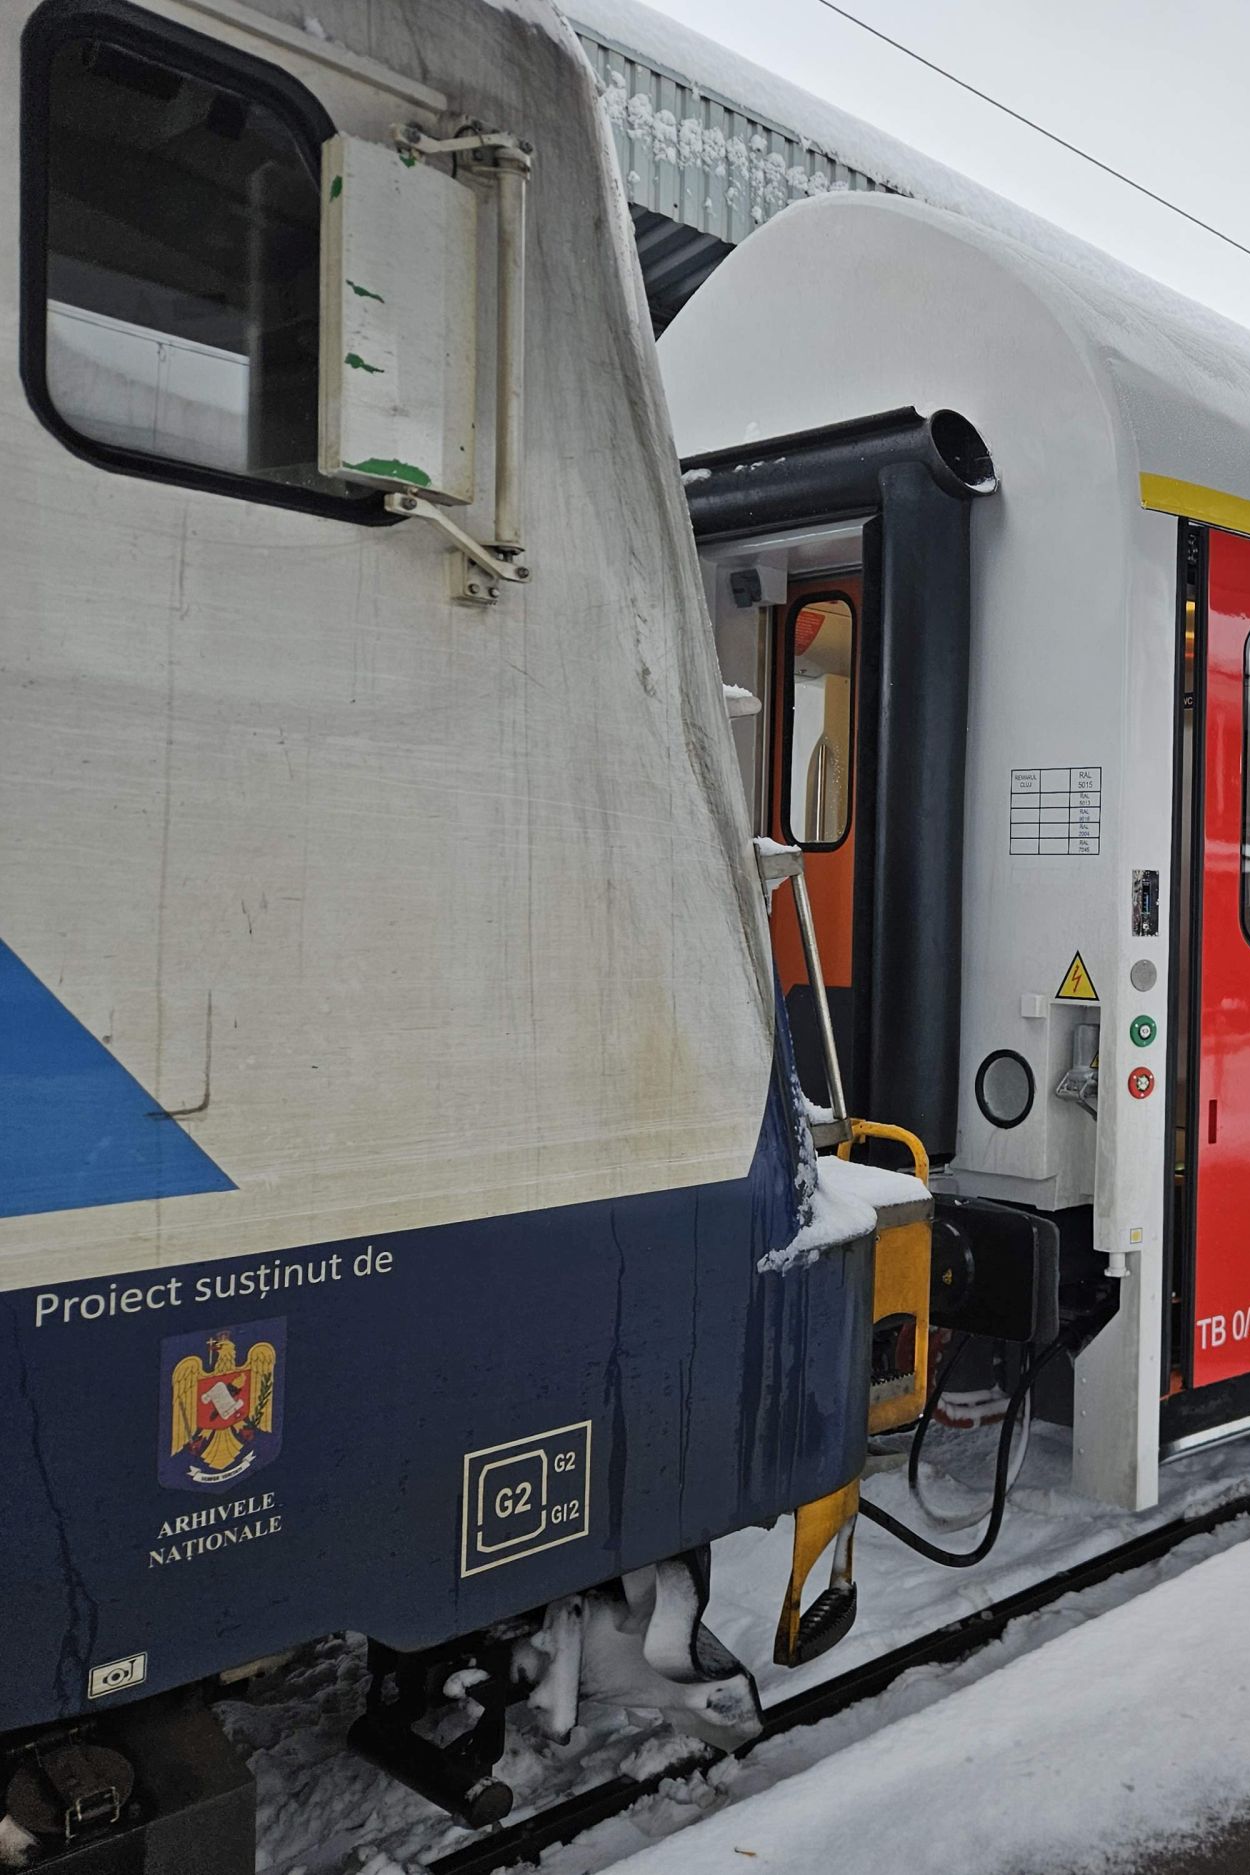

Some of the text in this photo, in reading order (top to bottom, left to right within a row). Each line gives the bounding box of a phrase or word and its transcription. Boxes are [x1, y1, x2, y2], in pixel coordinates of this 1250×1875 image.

[1078, 781, 1093, 789] 5015
[1079, 771, 1092, 779] RAL
[35, 1244, 394, 1328] Proiect susținut de
[1197, 1314, 1227, 1350] TB
[553, 1450, 576, 1473] G2
[157, 1491, 275, 1540] ARHIVELE
[494, 1480, 533, 1519] G2
[148, 1515, 282, 1569] NAȚIONALE
